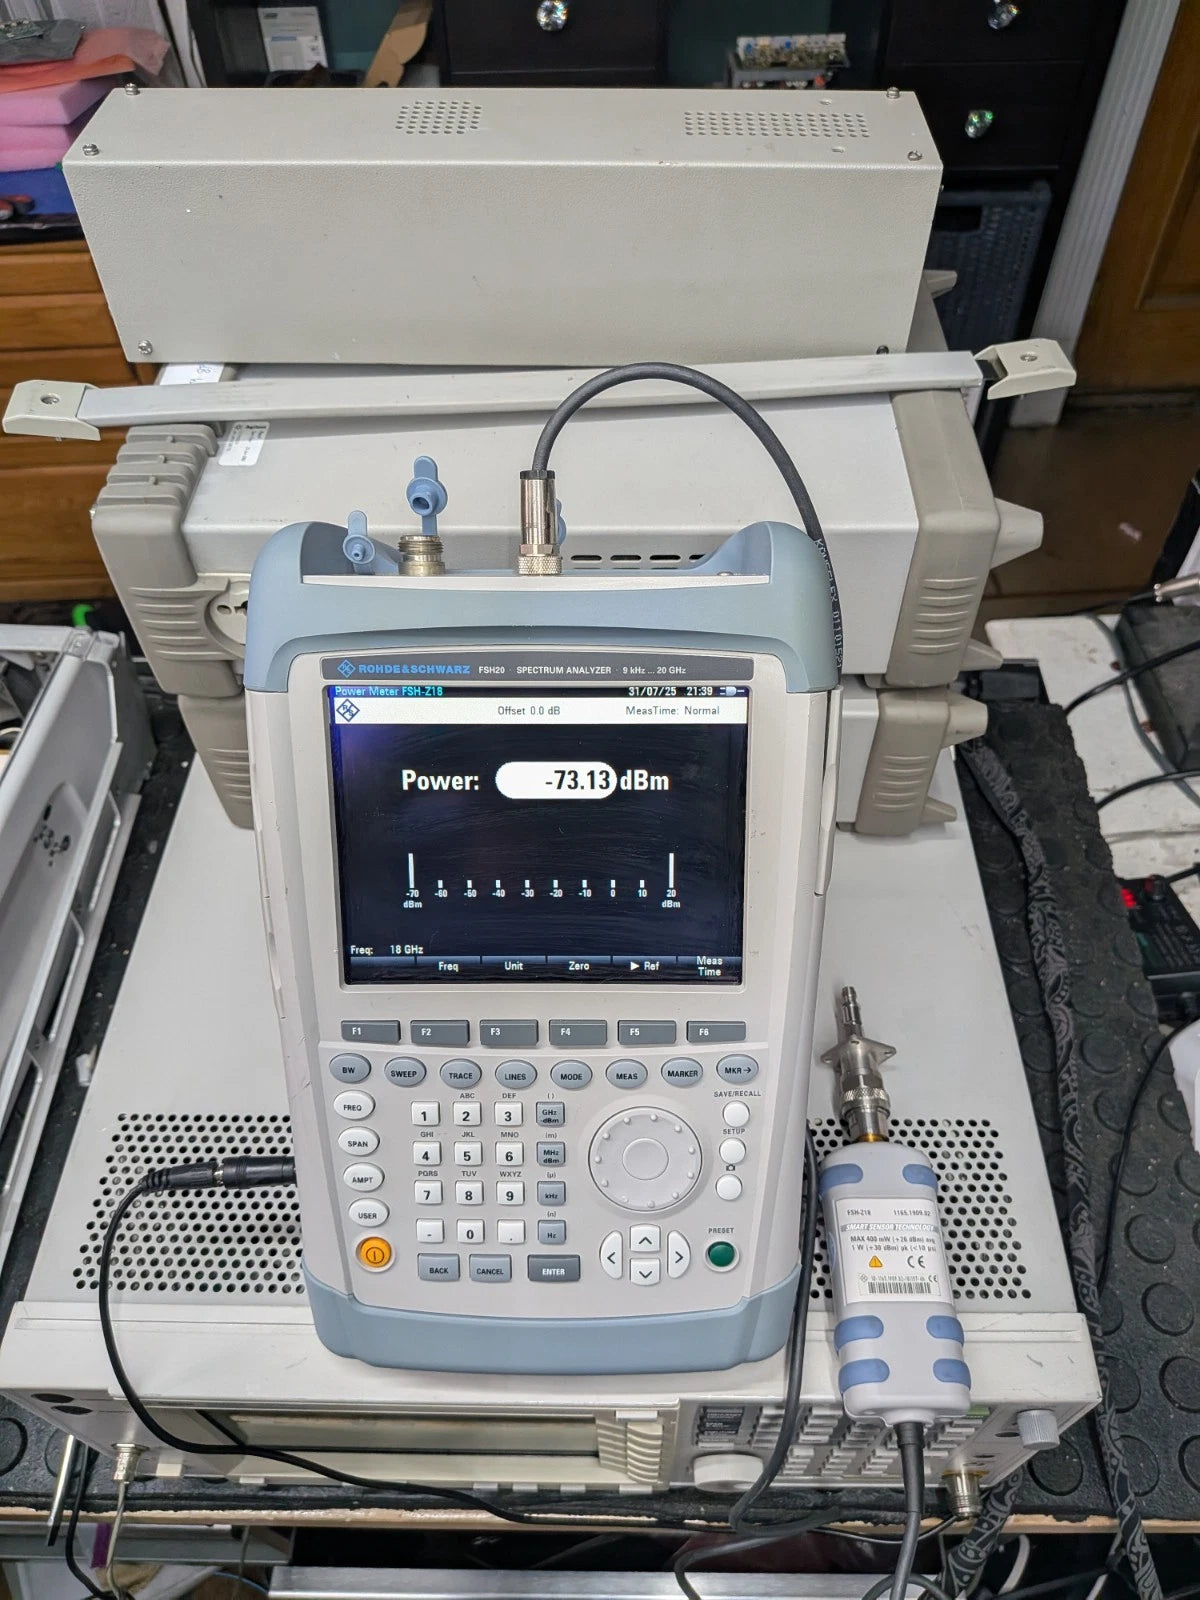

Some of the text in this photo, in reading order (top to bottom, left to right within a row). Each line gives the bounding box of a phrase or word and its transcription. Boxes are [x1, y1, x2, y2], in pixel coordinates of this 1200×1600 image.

[358, 664, 471, 674] ROHDE&SCHWARZ
[478, 666, 505, 674] FSH20
[516, 666, 564, 674] SPECTRUM
[566, 666, 612, 674] ANALYZER
[623, 666, 628, 674] 9
[630, 666, 645, 674] kHz
[657, 666, 667, 674] 20
[668, 666, 686, 674] GHz
[335, 686, 444, 696] Power Meter FSH-Z18
[628, 687, 713, 696] 31/07/25 21:39
[498, 706, 561, 715] Offset 0.0 dB
[625, 706, 720, 716] MeasTime: Normal
[402, 769, 670, 791] Power: -73.13 dBm
[406, 889, 419, 898] -70
[492, 889, 505, 898] -40
[521, 889, 534, 898] -30
[550, 889, 563, 898] -20
[578, 889, 591, 898] -10
[610, 889, 616, 898] 0
[638, 889, 647, 898] 10
[666, 889, 676, 898] 20
[403, 900, 423, 908] dBm
[661, 900, 681, 908] dBm
[350, 945, 423, 956] Freq: 18 GHz
[697, 956, 723, 965] Meas
[438, 961, 459, 972] Freq
[504, 961, 523, 970] Unit
[569, 961, 590, 970] Zero
[644, 961, 659, 970] Ref
[698, 967, 722, 976] Time
[421, 1028, 431, 1036] F2
[490, 1028, 500, 1036] F3
[560, 1028, 571, 1036] F4
[630, 1028, 640, 1036] F5
[699, 1028, 709, 1036] F6
[391, 1070, 417, 1078] SWEEP
[449, 1072, 473, 1080] TRACE
[504, 1073, 526, 1081] LINES
[560, 1073, 583, 1081] MODE
[616, 1072, 638, 1080] MEAS
[667, 1070, 698, 1078] MARKER
[343, 1104, 362, 1112] FREQ
[421, 1111, 427, 1121] 1
[462, 1111, 470, 1121] 2
[504, 1111, 512, 1121] 3
[347, 1140, 368, 1148] SPAN
[421, 1151, 429, 1161] 4
[463, 1151, 471, 1161] 5
[505, 1151, 513, 1161] 6
[423, 1190, 431, 1201] 7
[464, 1190, 473, 1201] 8
[506, 1190, 514, 1201] 9
[846, 1223, 934, 1231] SMART SENSOR TECHNOLOGY
[466, 1229, 474, 1240] 0
